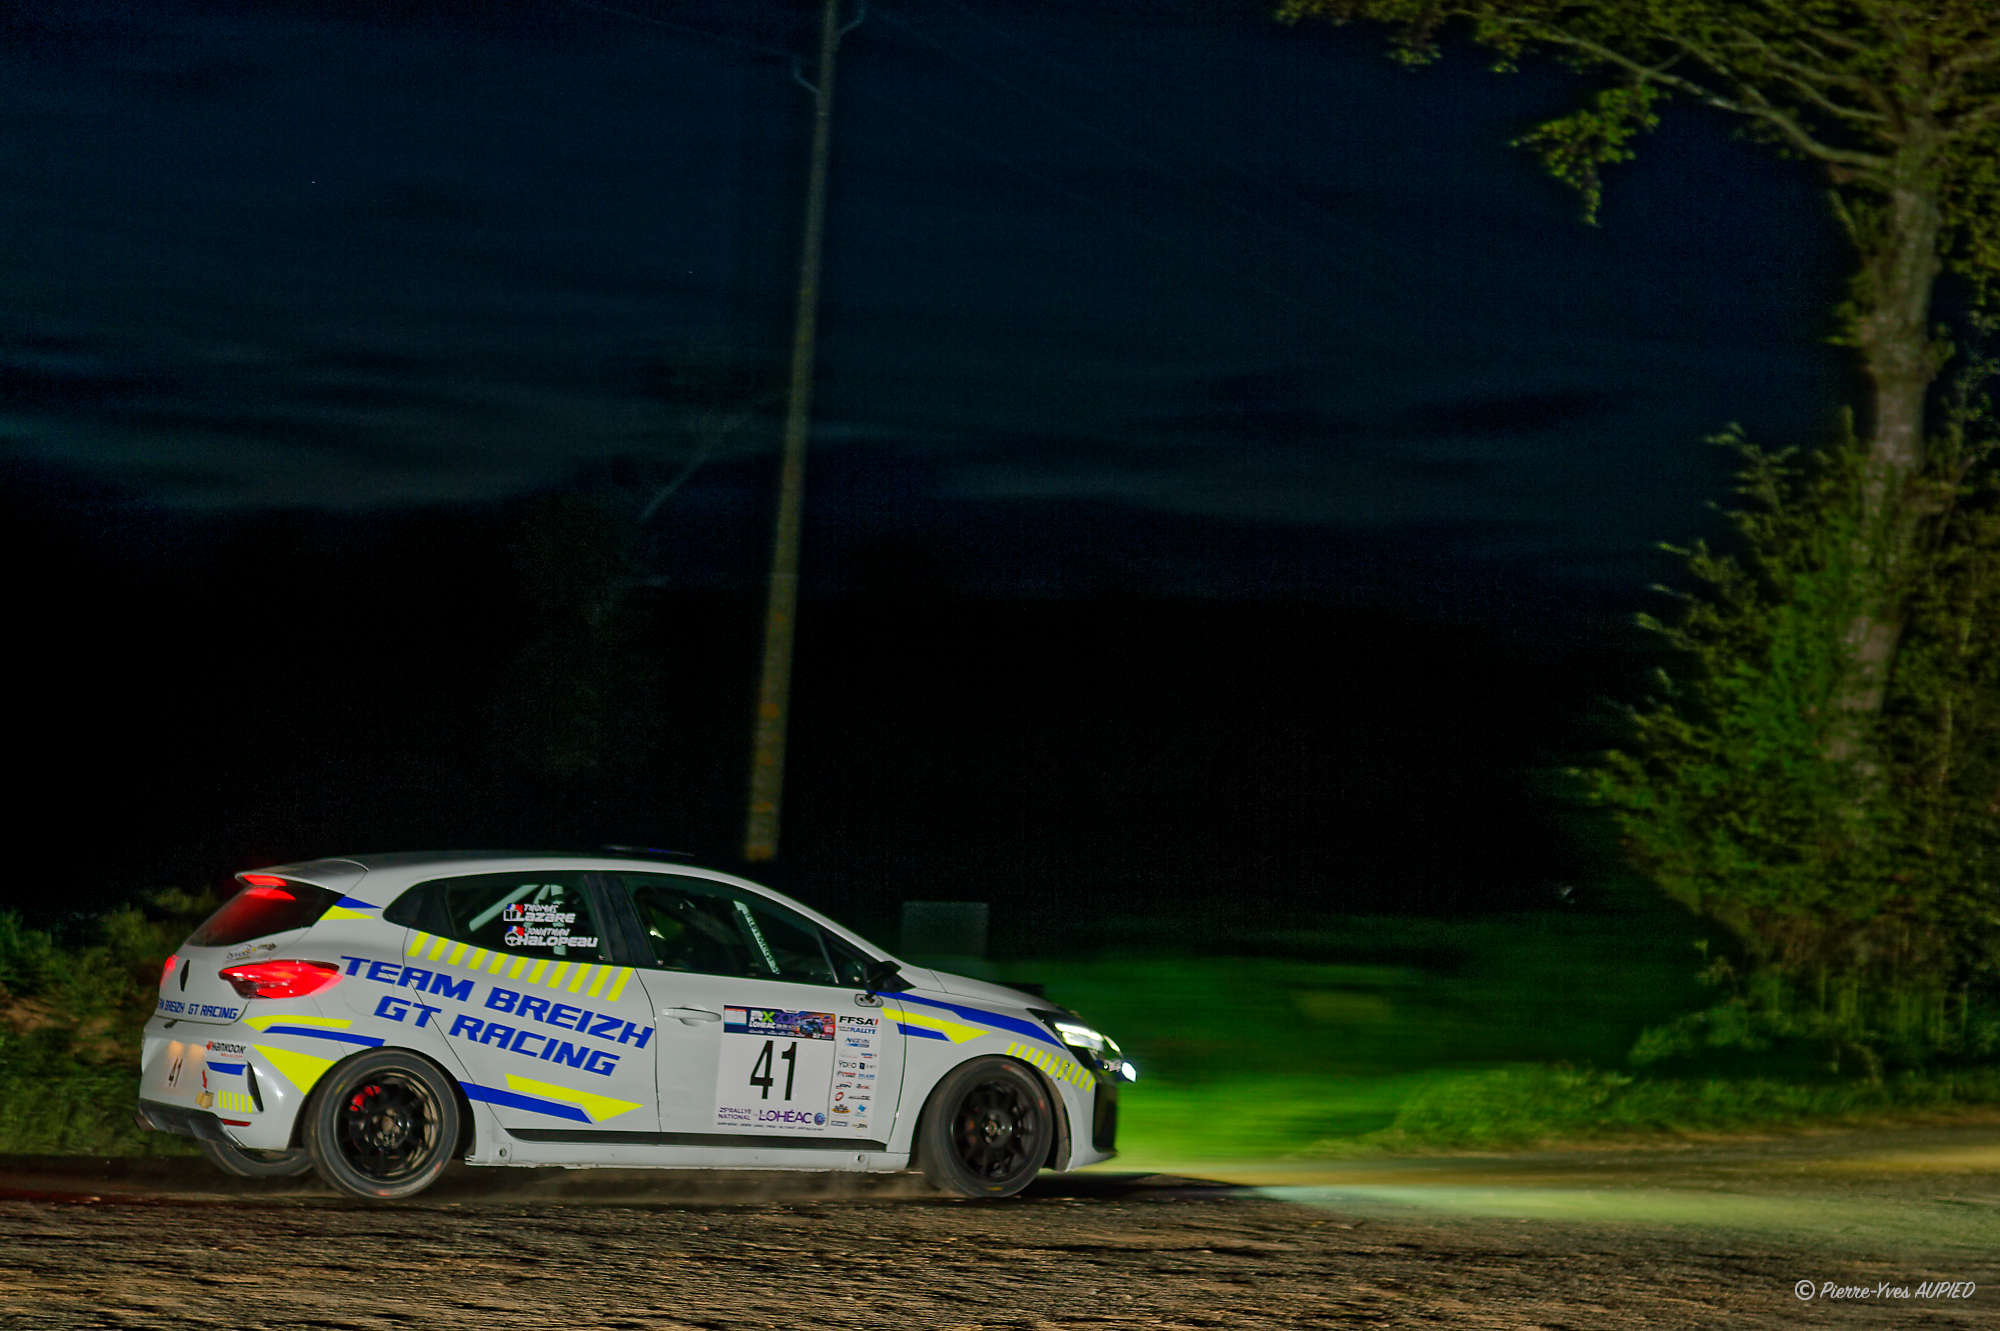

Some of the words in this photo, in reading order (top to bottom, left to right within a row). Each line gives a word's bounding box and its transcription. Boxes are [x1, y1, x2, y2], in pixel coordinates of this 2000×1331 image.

[188, 1002, 200, 1015] GT
[200, 1004, 239, 1020] RACING
[340, 955, 476, 1002] TEAM
[484, 986, 655, 1049] BREIZH
[373, 995, 442, 1028] GT
[449, 1013, 621, 1077] RACING
[839, 1015, 874, 1026] FFSA
[168, 1056, 183, 1088] 41
[749, 1039, 798, 1101] 41
[759, 1109, 813, 1124] LOHÉAC
